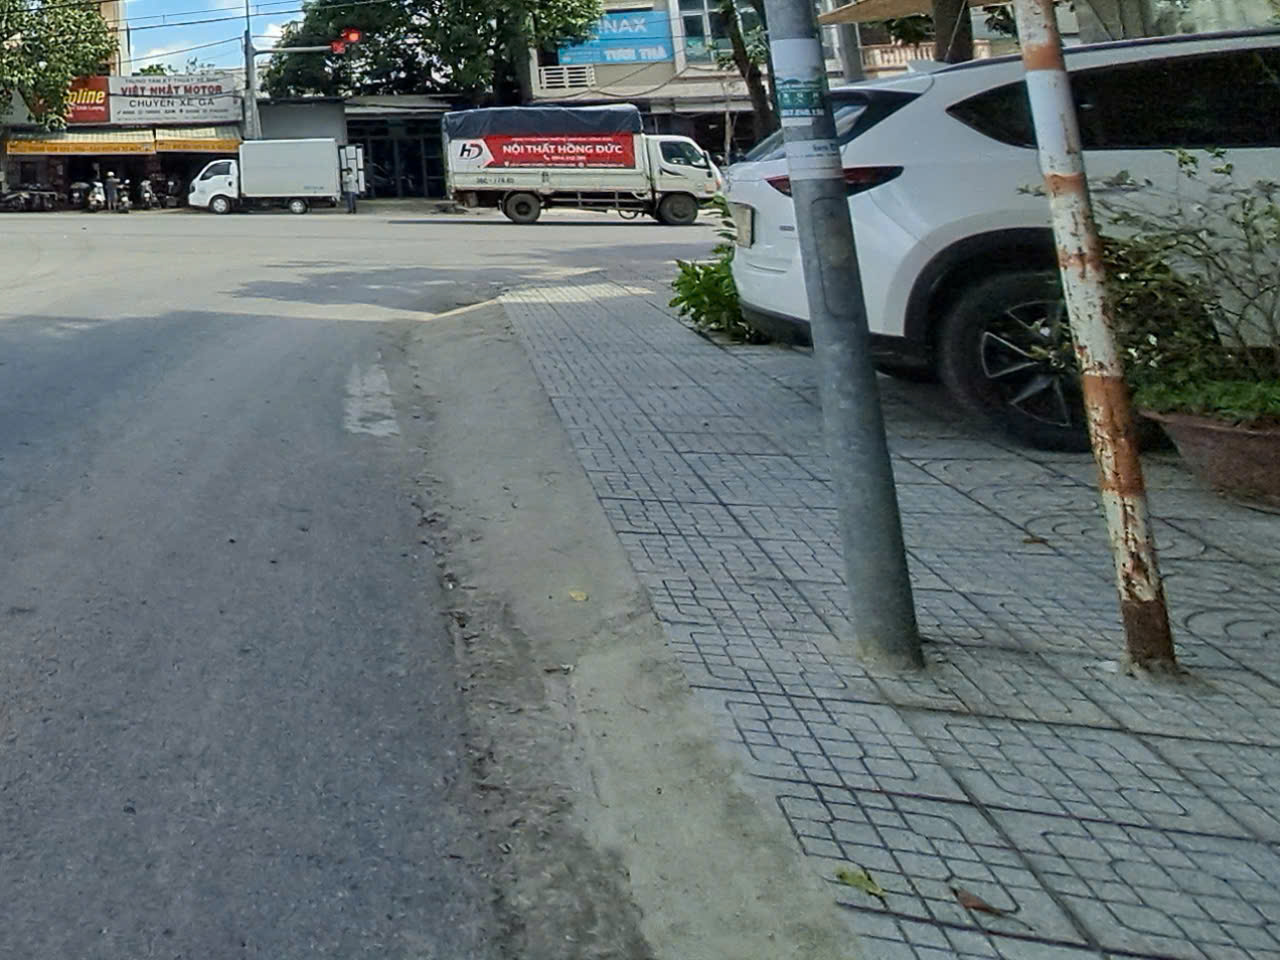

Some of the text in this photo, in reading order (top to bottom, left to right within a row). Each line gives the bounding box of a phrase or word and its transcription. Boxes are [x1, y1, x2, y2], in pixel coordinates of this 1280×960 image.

[183, 84, 223, 95] MOTOR
[503, 143, 524, 156] NỘI
[526, 142, 556, 154] THẤT
[596, 142, 623, 154] ĐỨC
